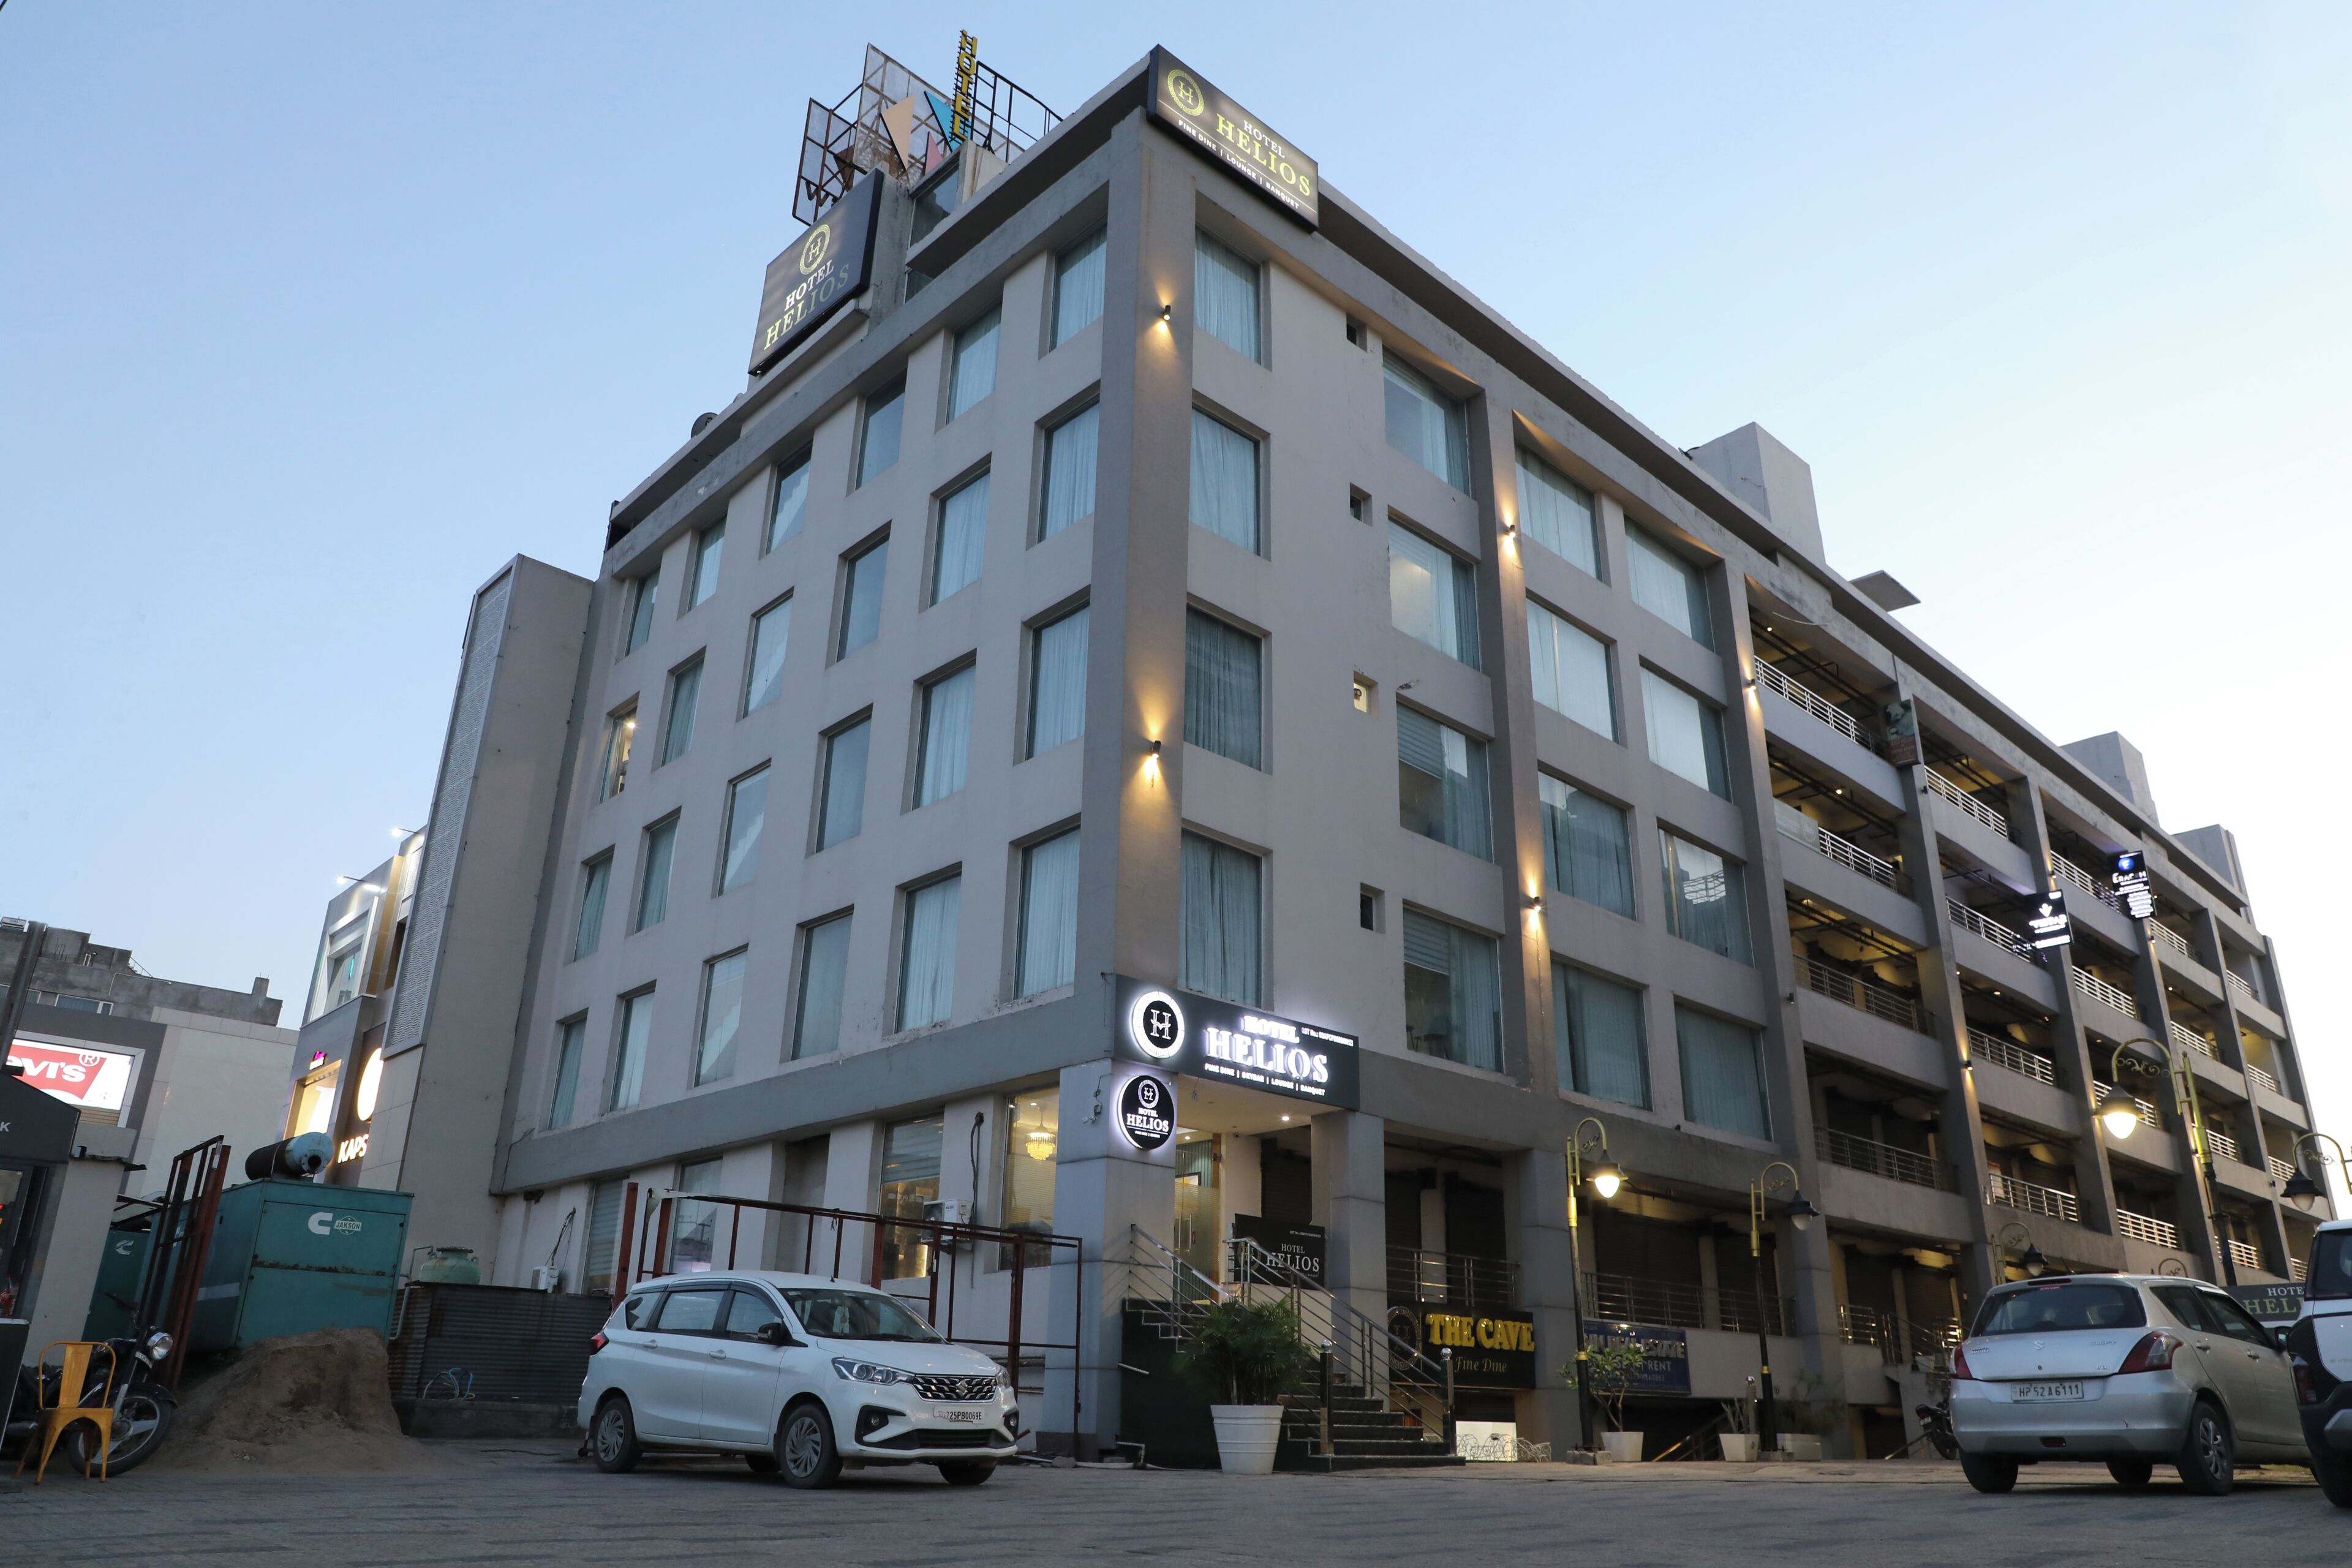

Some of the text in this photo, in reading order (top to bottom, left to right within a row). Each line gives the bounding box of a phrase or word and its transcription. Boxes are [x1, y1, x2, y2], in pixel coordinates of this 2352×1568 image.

[953, 29, 978, 141] HOTEL
[1243, 119, 1286, 159] HOTEL
[1178, 119, 1300, 209] FINE DINE LOUNGE BANQUET
[1216, 113, 1311, 197] HELIOS
[784, 259, 834, 312] HOTEL
[764, 263, 850, 350] HELIOS
[1243, 1015, 1300, 1044] HOTEL
[1206, 1027, 1329, 1084] HELIOS
[1272, 1078, 1294, 1089] LOUNGE
[1300, 1084, 1326, 1096] BANQUET
[1126, 1114, 1169, 1133] HELIOS
[1138, 1107, 1158, 1118] HOTEL
[337, 1134, 369, 1164] KAPS
[336, 1221, 360, 1230] JAKSON
[1281, 1243, 1305, 1254] HOTEL
[1266, 1252, 1319, 1272] HELIOS
[2267, 1286, 2305, 1297] HOTE
[2242, 1297, 2304, 1314] HEL
[1426, 1313, 1535, 1352] THE CAVE
[1454, 1356, 1507, 1373] Fine Dine
[1648, 1360, 1672, 1372] RENT
